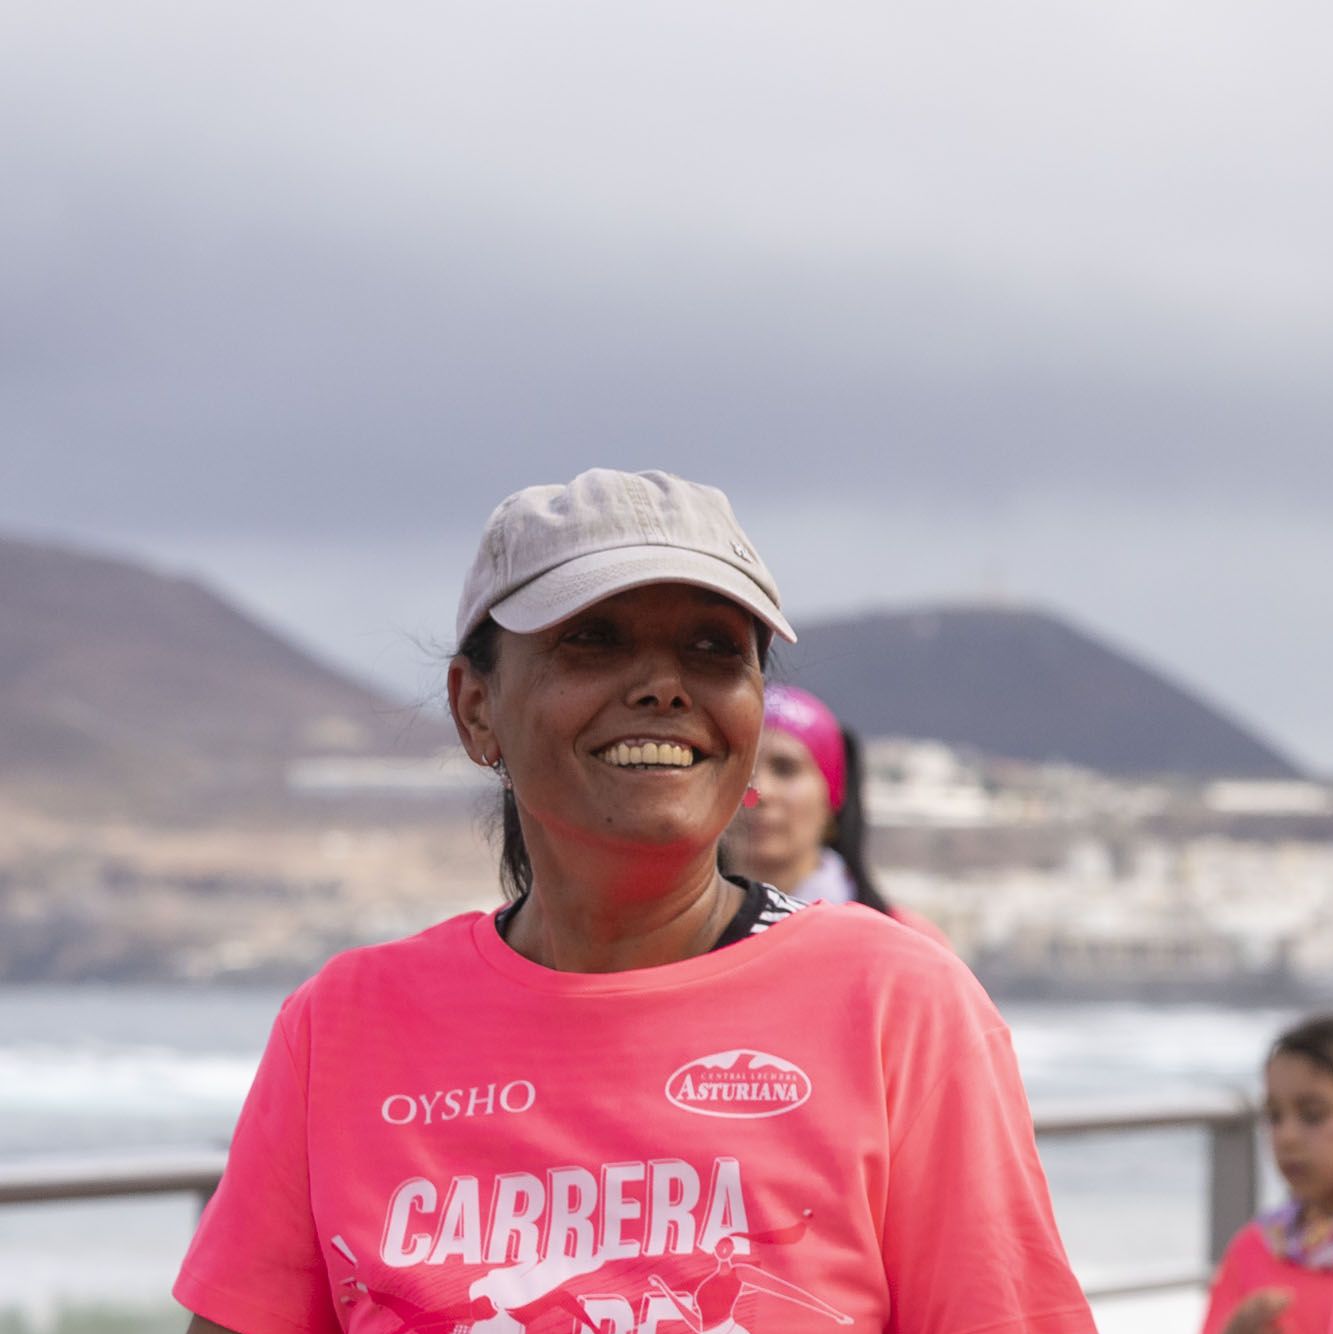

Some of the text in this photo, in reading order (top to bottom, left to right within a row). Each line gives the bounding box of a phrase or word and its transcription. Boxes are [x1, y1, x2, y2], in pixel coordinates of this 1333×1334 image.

[381, 1079, 536, 1125] OYSHO
[676, 1073, 799, 1101] ASTURIANA
[380, 1157, 751, 1268] CARRERA
